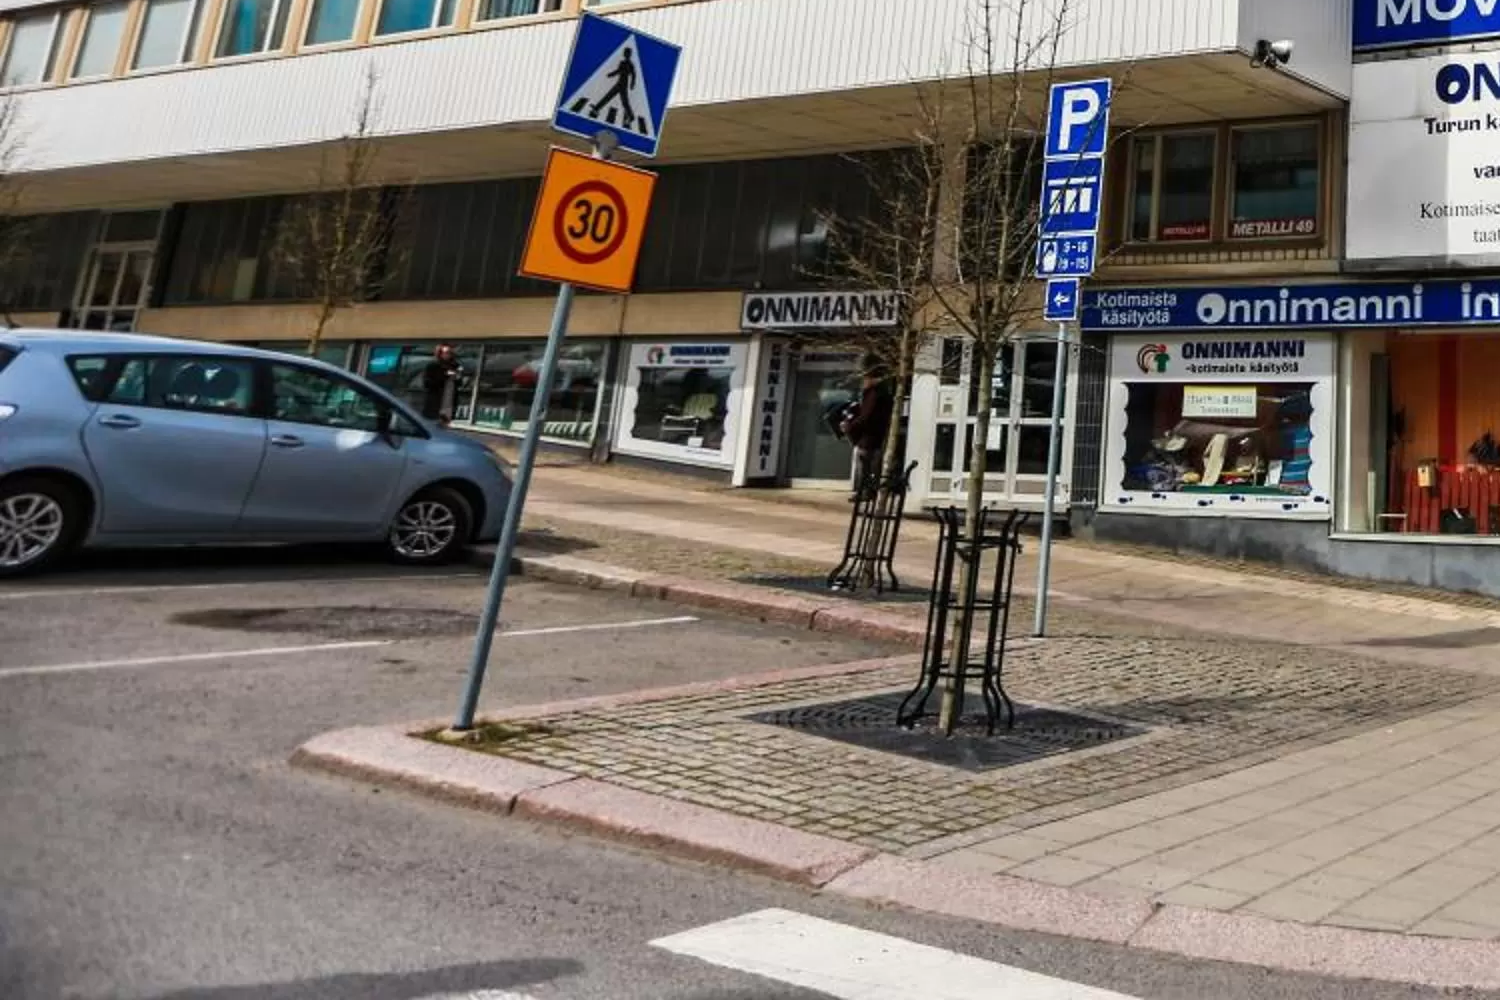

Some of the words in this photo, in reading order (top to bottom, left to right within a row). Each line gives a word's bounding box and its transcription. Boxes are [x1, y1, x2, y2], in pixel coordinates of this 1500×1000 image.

[1058, 87, 1100, 151] P
[1424, 117, 1481, 135] Turun
[568, 199, 615, 243] 30
[1233, 221, 1293, 236] METALLI
[1295, 219, 1314, 233] 49
[1097, 290, 1177, 307] Kotimaista
[1196, 284, 1424, 325] Onnimanni
[747, 295, 895, 323] ONNIMANNI
[1101, 308, 1171, 327] käsityötä
[1182, 340, 1305, 359] ONNIMANNI
